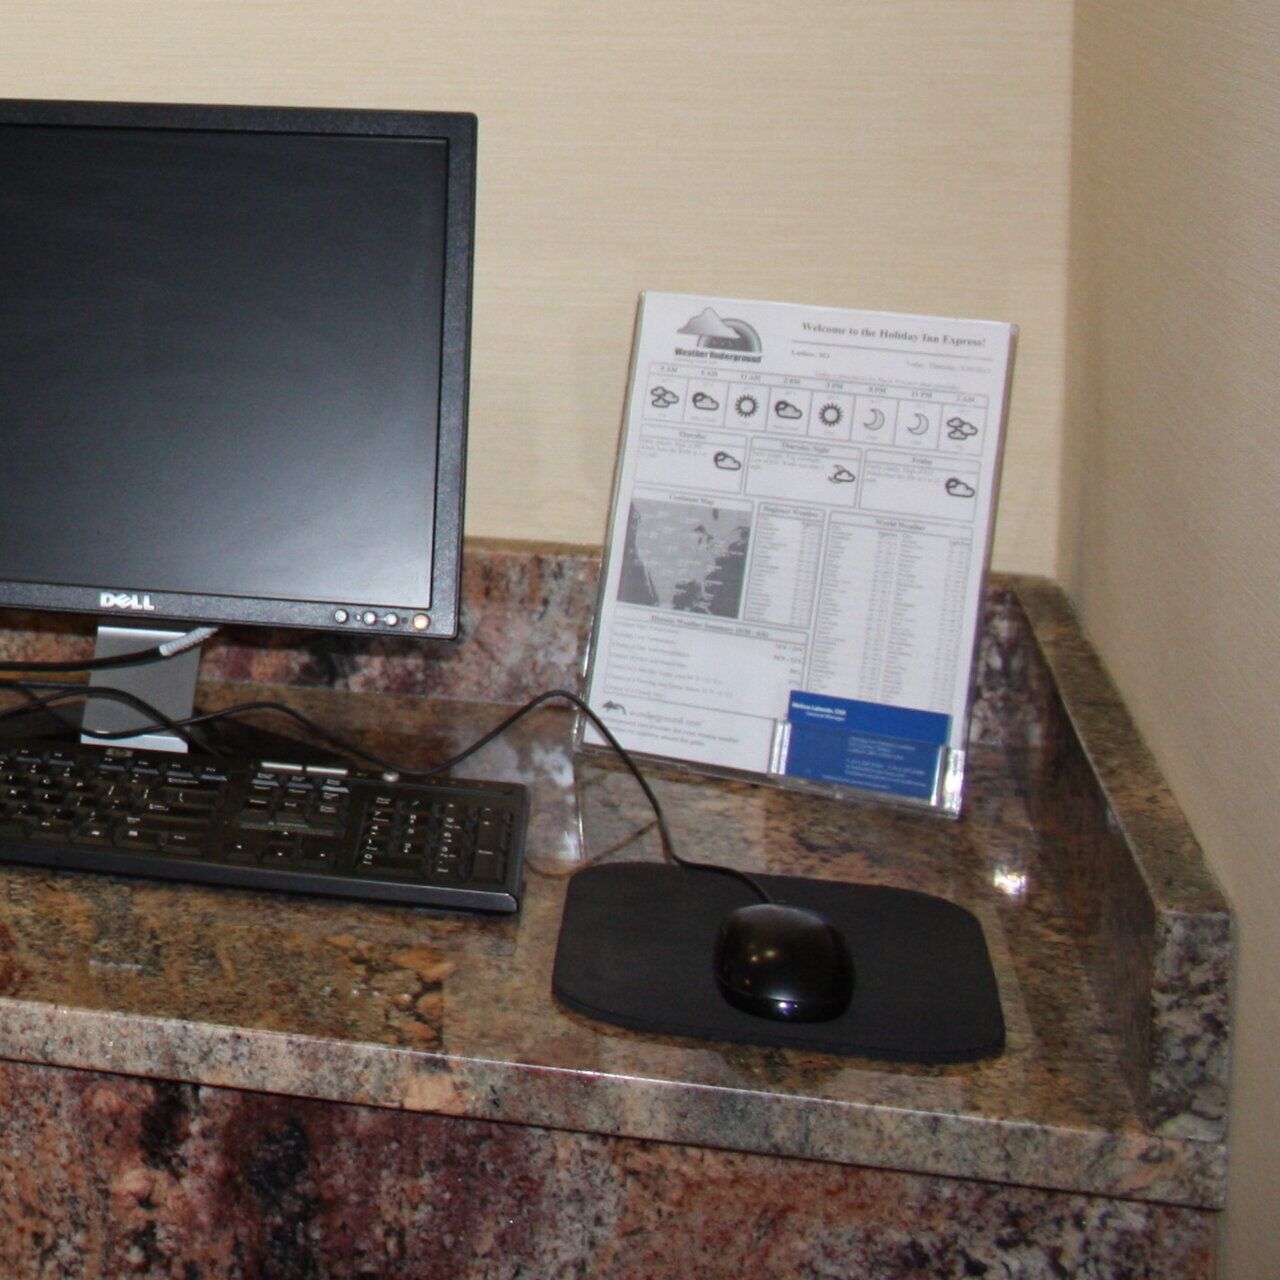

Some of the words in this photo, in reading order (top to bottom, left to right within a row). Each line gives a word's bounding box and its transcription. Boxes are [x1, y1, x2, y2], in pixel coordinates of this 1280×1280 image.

[802, 321, 845, 335] Welcome
[849, 328, 859, 336] to
[860, 328, 877, 337] the
[879, 329, 918, 344] Holiday
[922, 332, 940, 344] Inn
[942, 334, 987, 348] Express!
[674, 347, 708, 358] Weather
[709, 351, 762, 363] Underground
[99, 592, 155, 611] DELL
